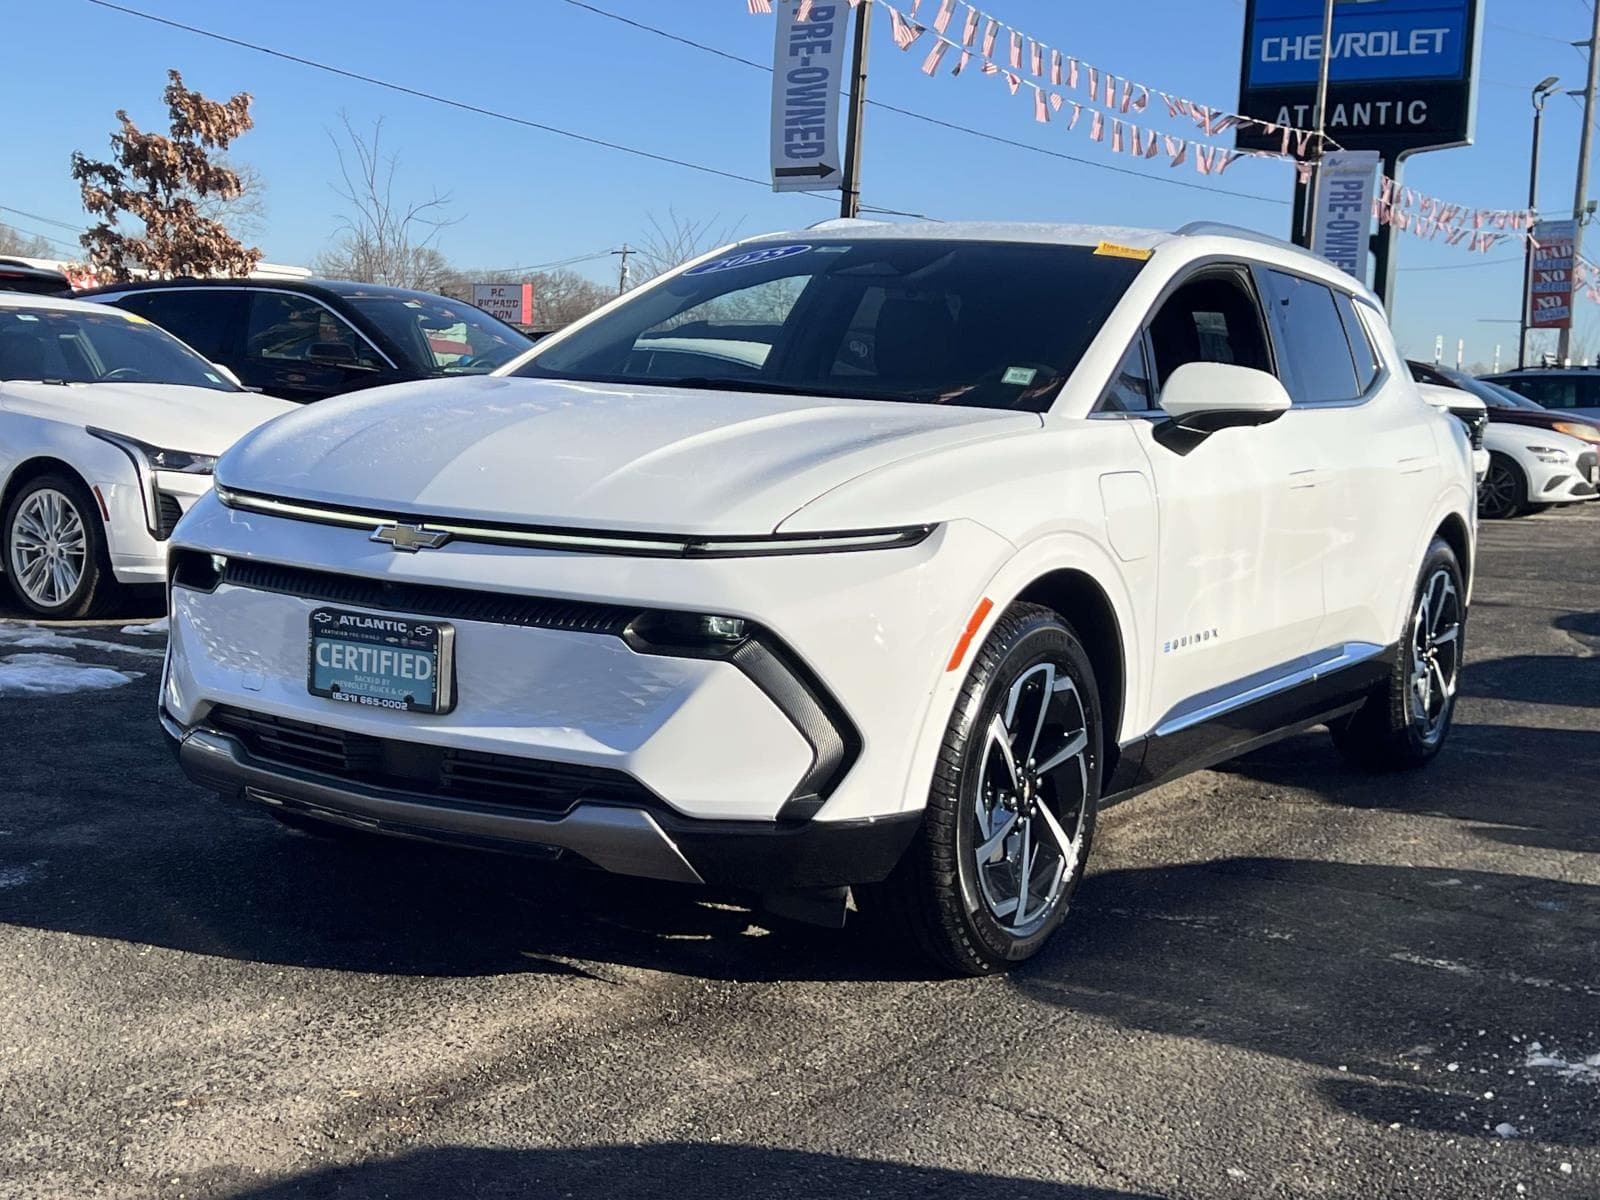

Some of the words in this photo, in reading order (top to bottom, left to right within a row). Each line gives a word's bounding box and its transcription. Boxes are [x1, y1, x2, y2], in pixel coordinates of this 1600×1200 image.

[1261, 28, 1450, 62] CHEVROLET
[784, 5, 836, 160] PRE-OWNED
[1323, 180, 1364, 277] PRE-OWNE
[339, 615, 407, 633] ATLANTIC
[1163, 628, 1219, 653] EQUINOX
[316, 643, 432, 680] CERTIFIED
[360, 696, 408, 711] 665-0002
